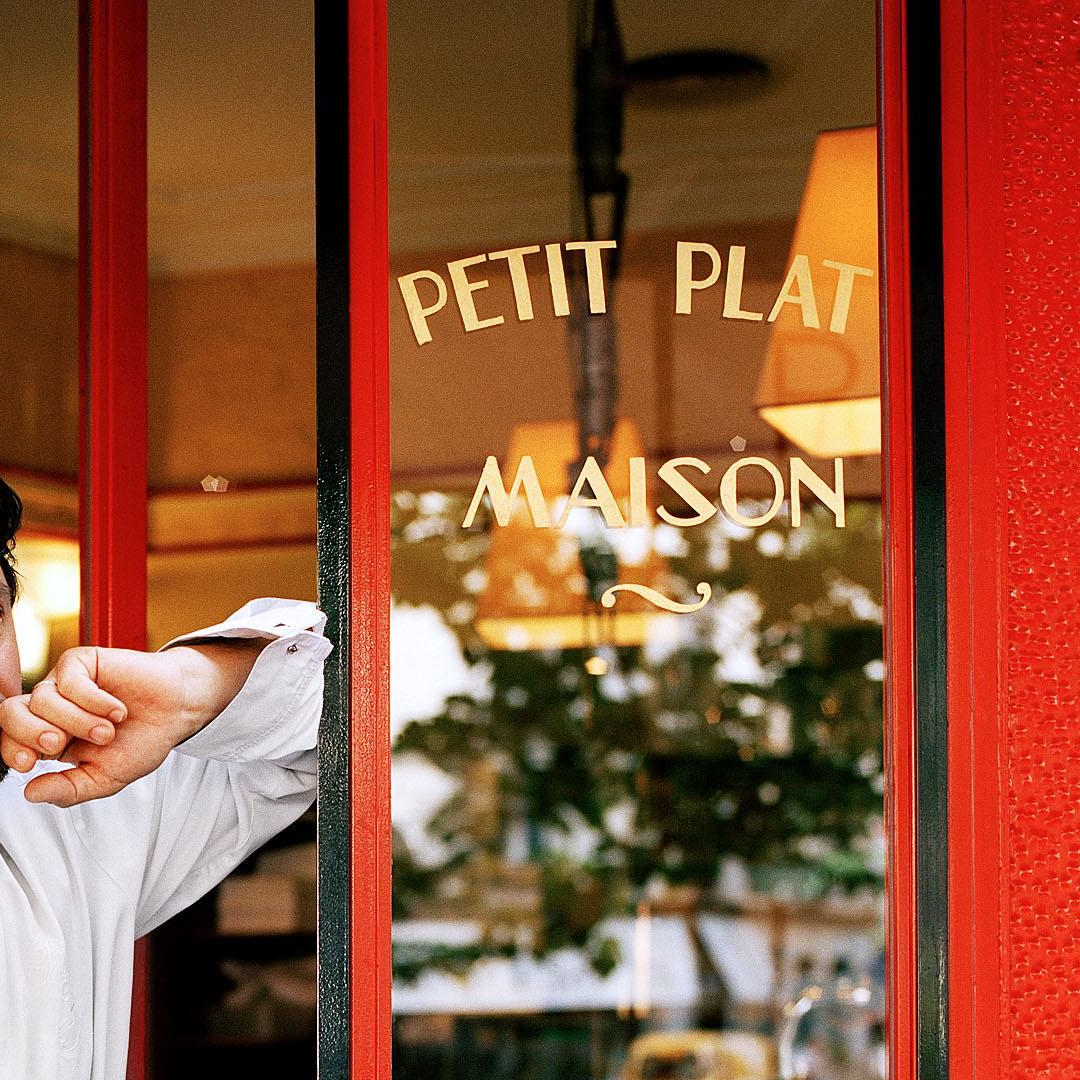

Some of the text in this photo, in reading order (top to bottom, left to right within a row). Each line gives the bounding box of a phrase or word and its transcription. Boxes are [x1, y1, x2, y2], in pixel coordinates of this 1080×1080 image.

[397, 240, 873, 346] PETIT PLAT
[461, 456, 846, 528] MAISON
